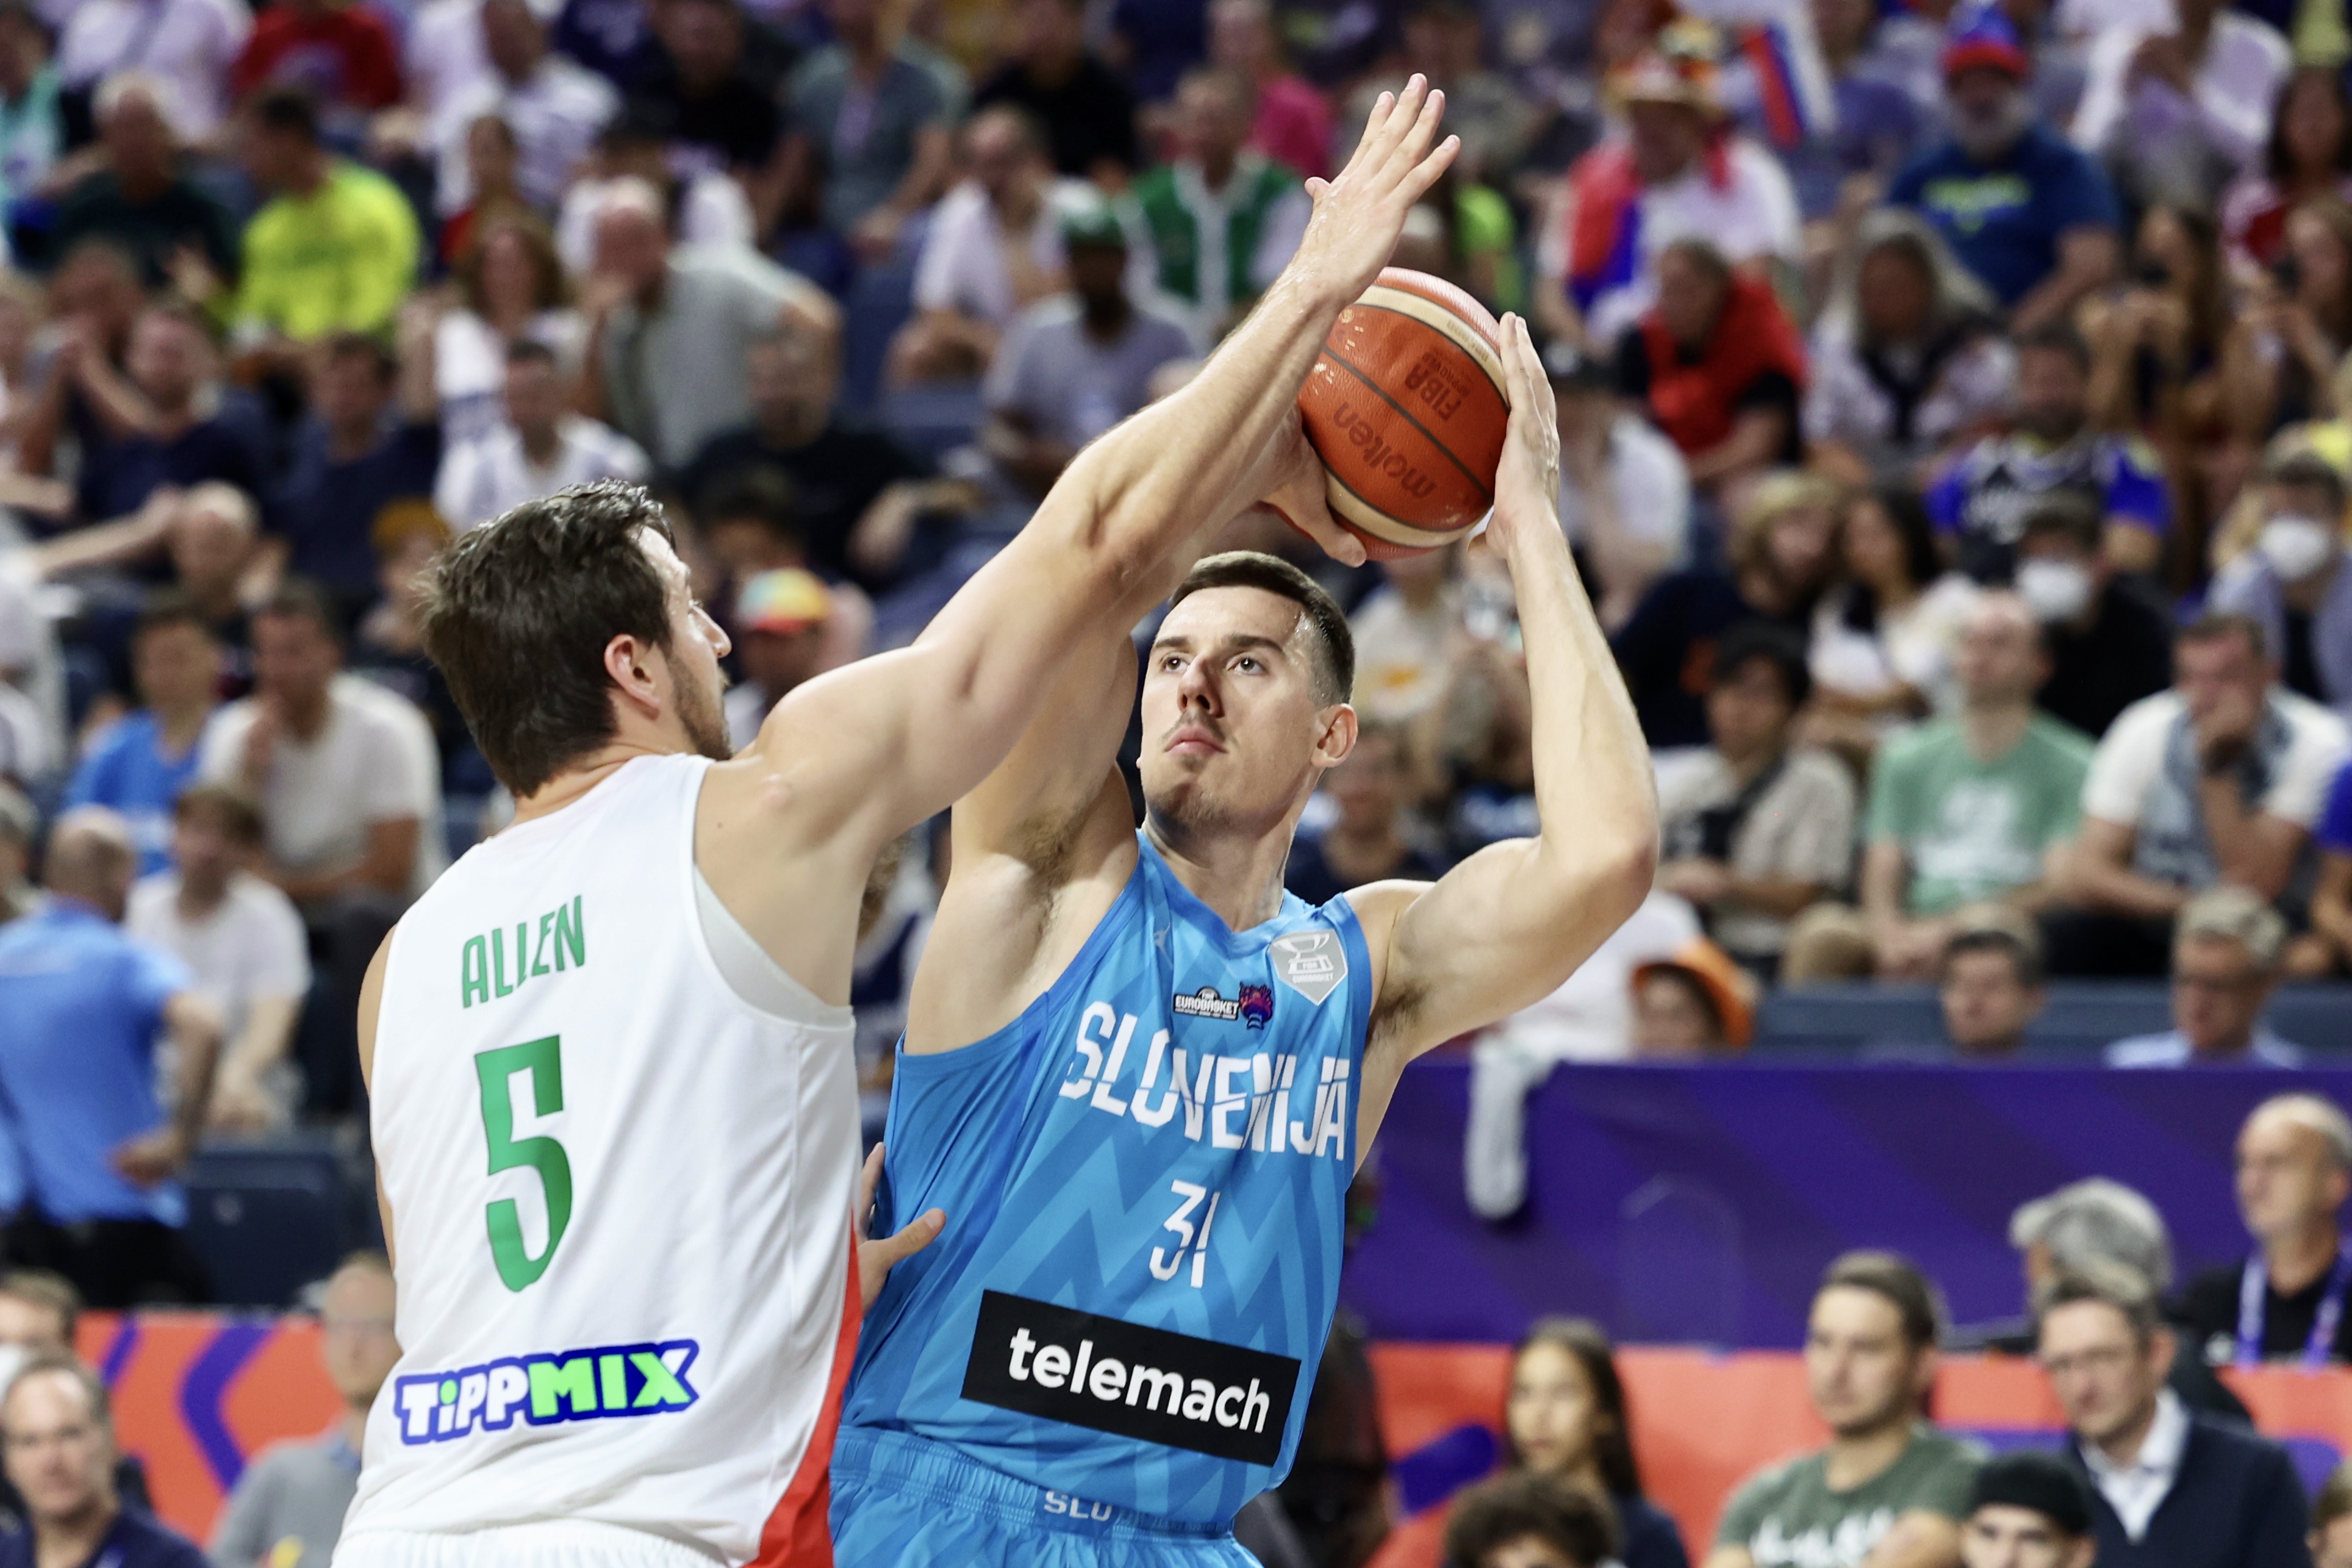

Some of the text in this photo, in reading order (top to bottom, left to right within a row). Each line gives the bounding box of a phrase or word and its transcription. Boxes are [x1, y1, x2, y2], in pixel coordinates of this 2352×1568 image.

[1405, 362, 1462, 421] FIBA
[1333, 402, 1438, 499] molten
[462, 895, 585, 1008] ALLEN
[1175, 995, 1239, 1015] EUROBASKET
[1059, 1000, 1350, 1161] SLOVENIJA
[475, 1034, 573, 1292] 5
[1149, 1180, 1221, 1289] 31
[1008, 1327, 1270, 1433] telemach
